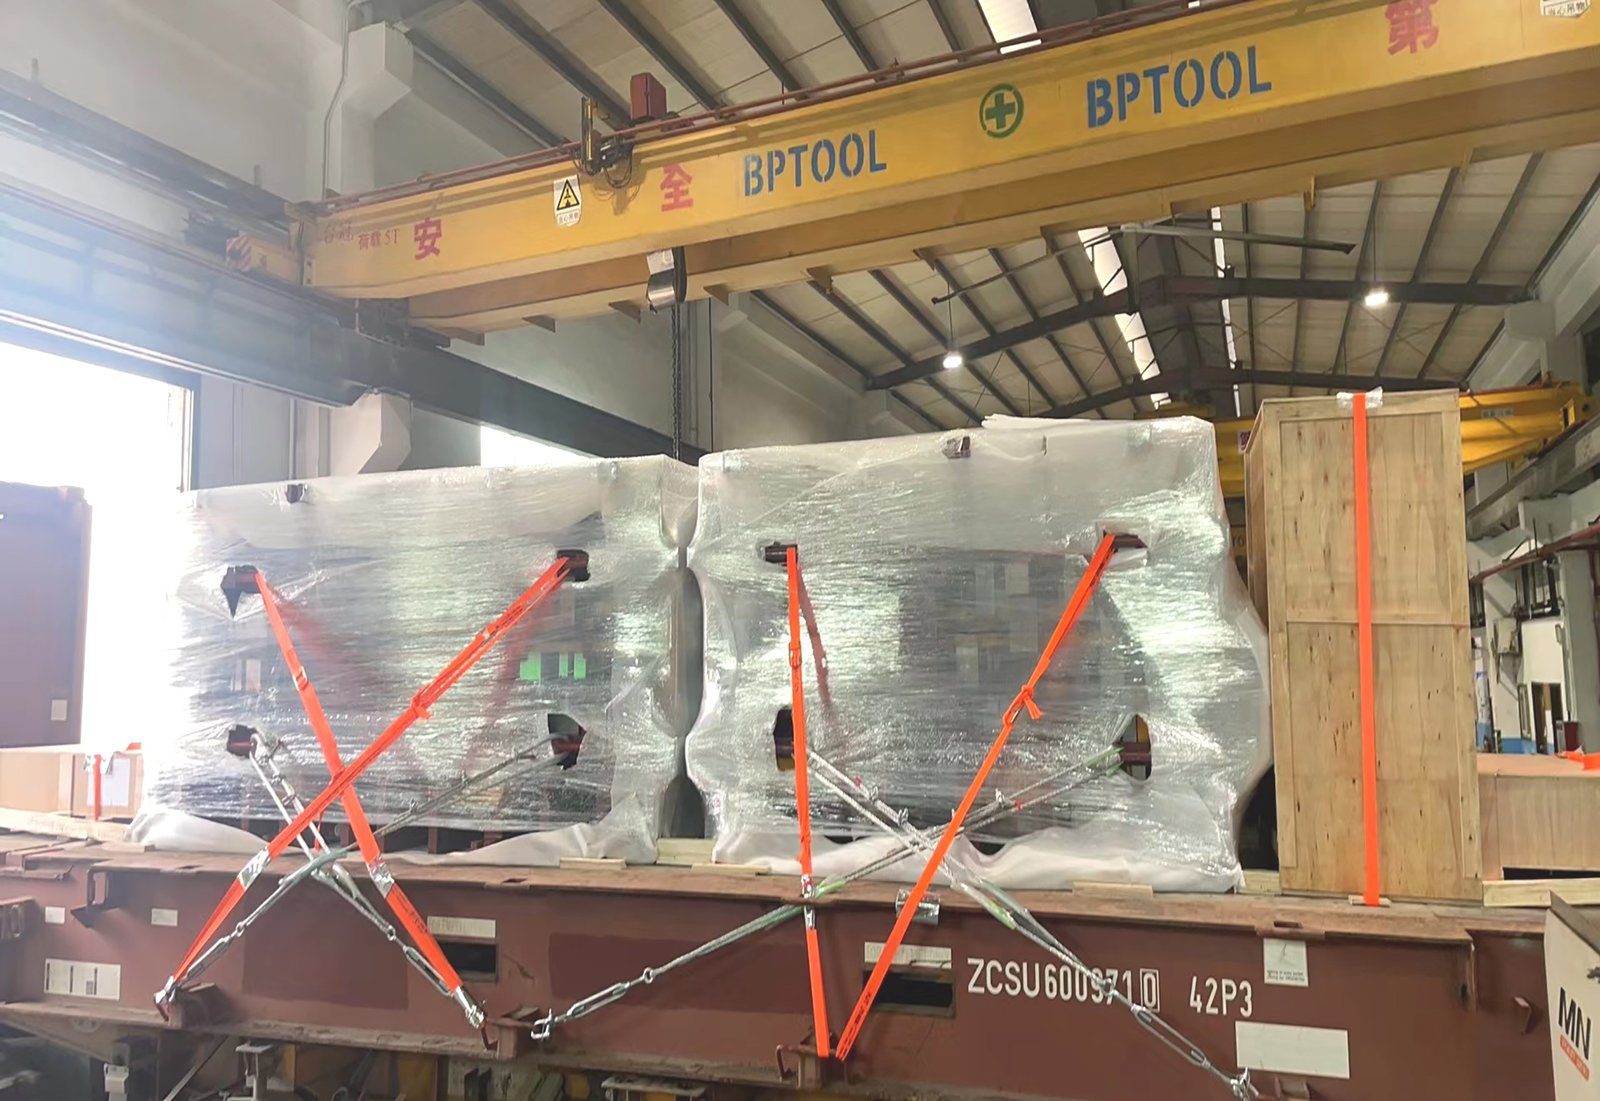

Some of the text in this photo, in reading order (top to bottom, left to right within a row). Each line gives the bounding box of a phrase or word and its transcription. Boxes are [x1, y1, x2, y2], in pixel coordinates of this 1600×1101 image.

[1087, 45, 1272, 128] BPTOOL
[660, 163, 694, 212] 全
[744, 128, 887, 196] BPTOOL
[414, 217, 442, 260] 安
[1189, 975, 1254, 1018] 42P3
[1558, 987, 1592, 1061] MN
